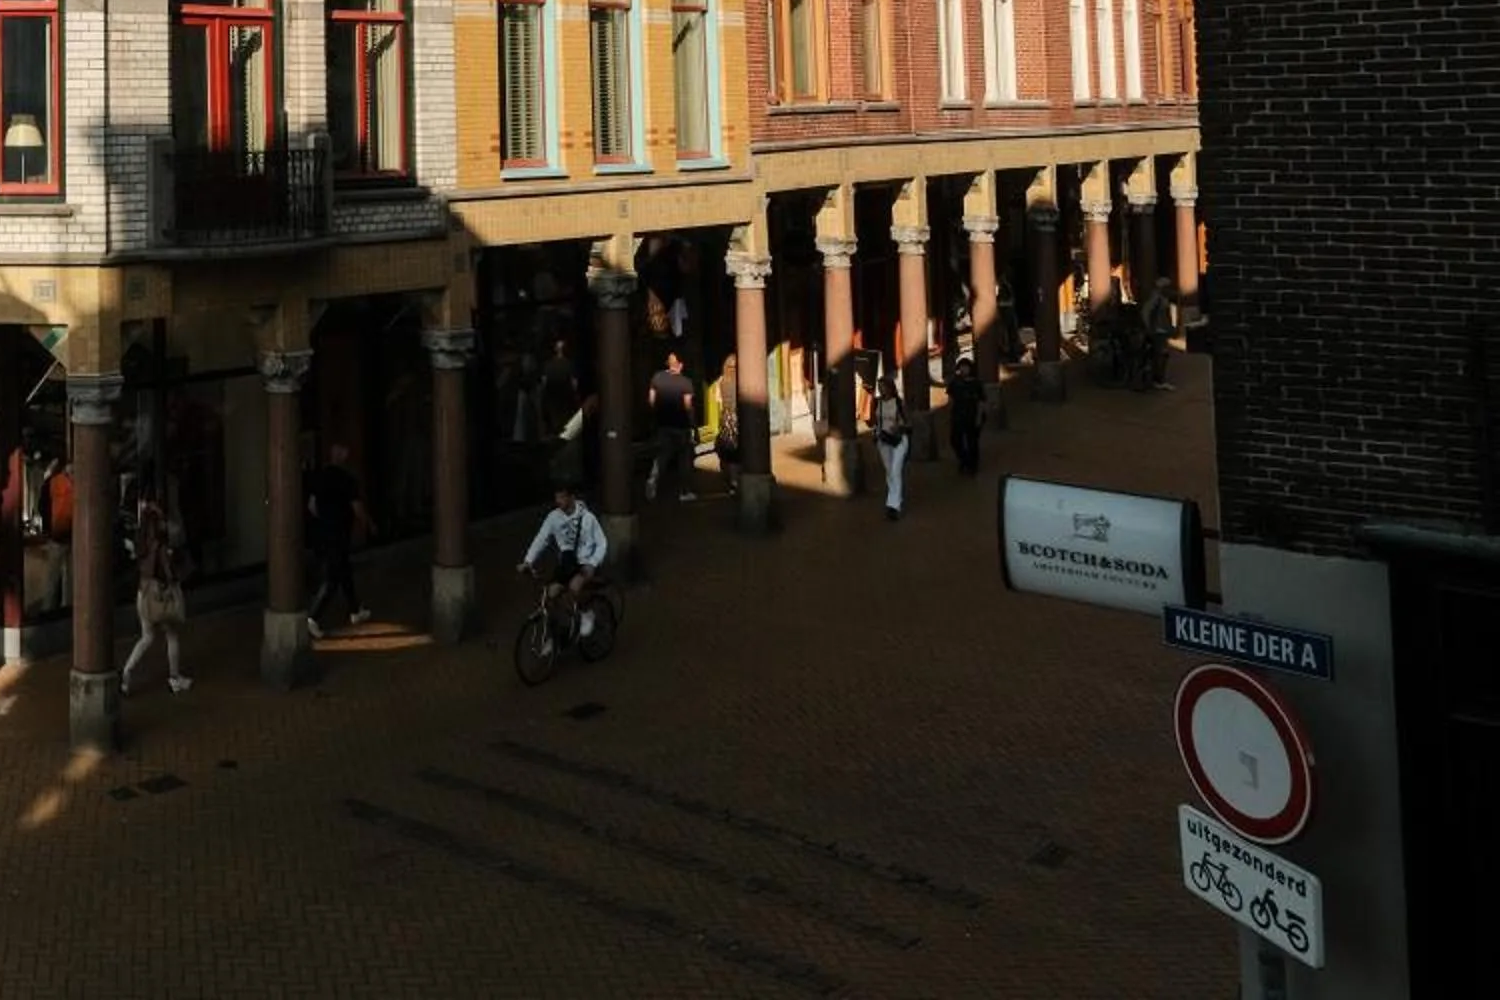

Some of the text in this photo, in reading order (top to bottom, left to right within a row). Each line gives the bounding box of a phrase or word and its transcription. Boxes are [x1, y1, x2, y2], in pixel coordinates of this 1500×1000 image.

[1017, 540, 1169, 580] SCOTCH&SODA
[1174, 614, 1317, 669] KLEINE DER A
[1186, 818, 1307, 898] uitgezonderd
